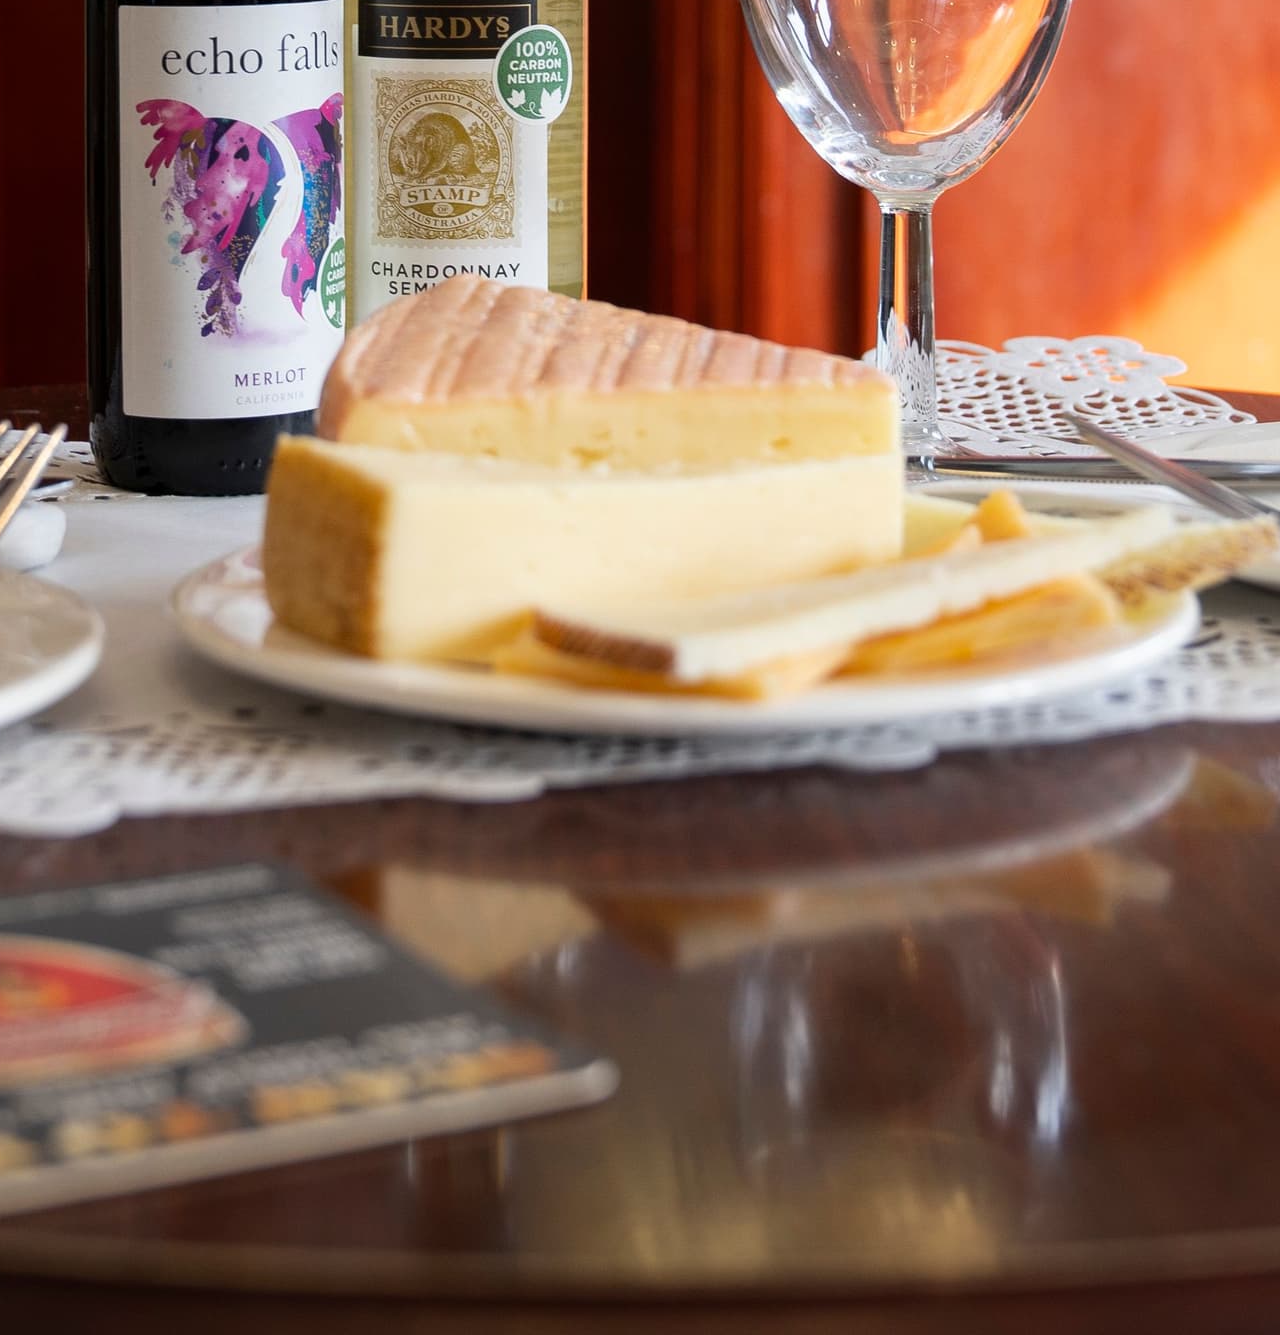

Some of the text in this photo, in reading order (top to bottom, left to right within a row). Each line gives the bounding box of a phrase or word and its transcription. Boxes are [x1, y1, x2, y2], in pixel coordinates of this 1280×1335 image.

[161, 29, 340, 76] echo falls
[515, 40, 559, 58] 100%
[509, 57, 562, 71] CARBON
[507, 70, 564, 85] NEUTRAL
[387, 96, 422, 130] THOMAS
[423, 92, 464, 103] HARDY
[476, 104, 500, 131] SONS
[406, 187, 481, 204] STAMP
[409, 209, 480, 228] AUSTRALIA
[371, 261, 521, 280] CHARDONNAY
[234, 367, 307, 387] MERLOT
[235, 390, 305, 406] CALIFORNIA
